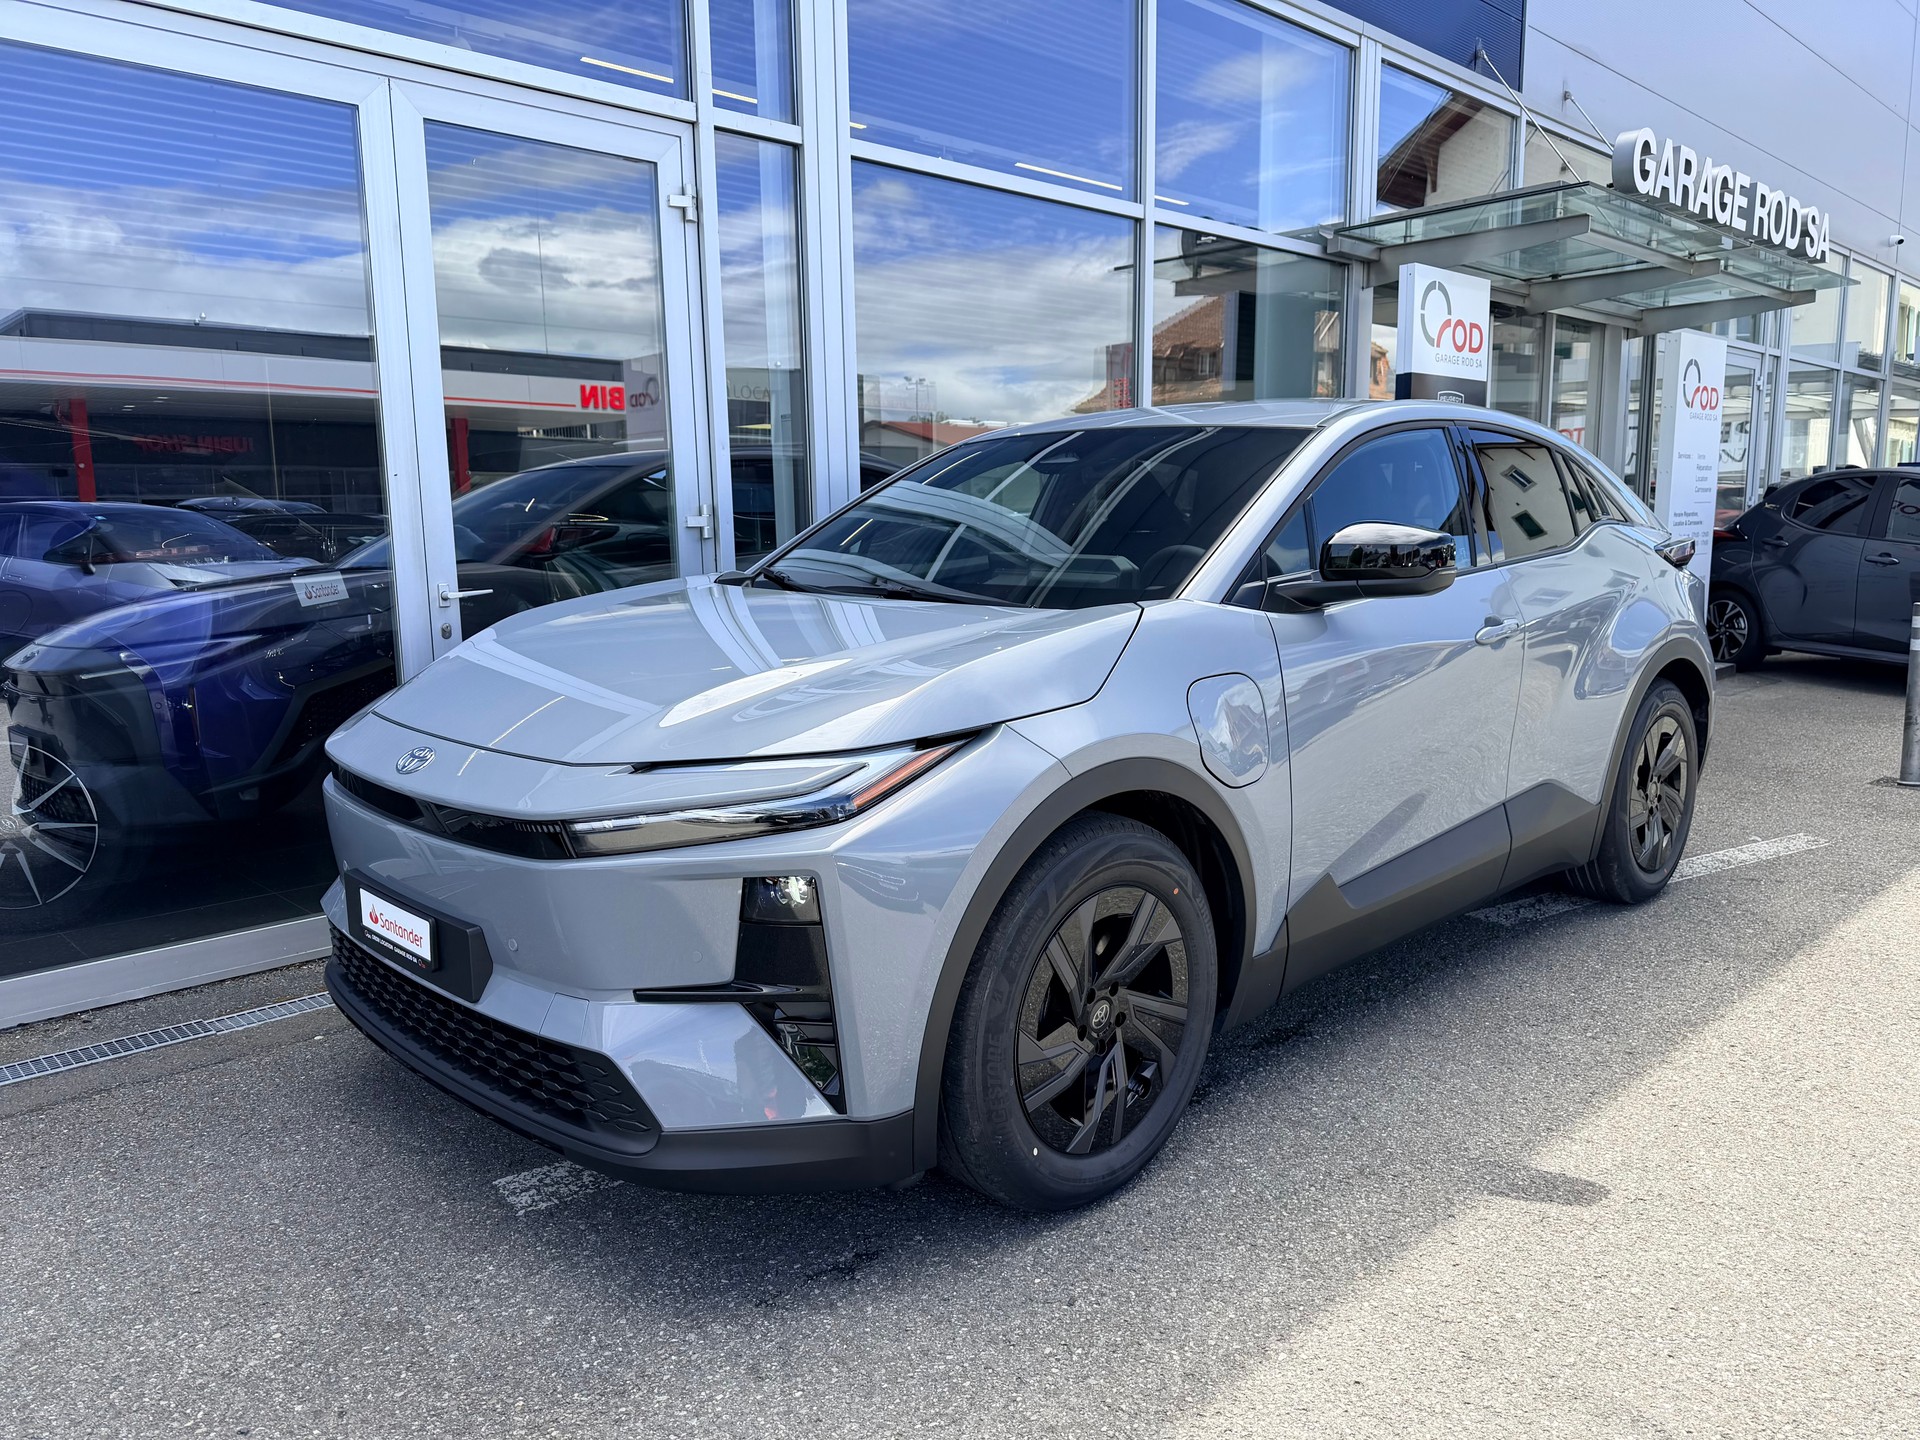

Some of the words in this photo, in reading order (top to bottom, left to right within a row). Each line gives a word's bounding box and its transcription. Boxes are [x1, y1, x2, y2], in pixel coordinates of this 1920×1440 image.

[1632, 127, 1750, 232] GARAGE
[1752, 181, 1801, 250] ROD
[1804, 205, 1830, 263] SA
[1435, 353, 1460, 365] GARAGE
[1461, 356, 1474, 367] ROD
[1475, 358, 1483, 368] SA
[311, 582, 340, 599] Santander
[379, 912, 423, 948] Santander
